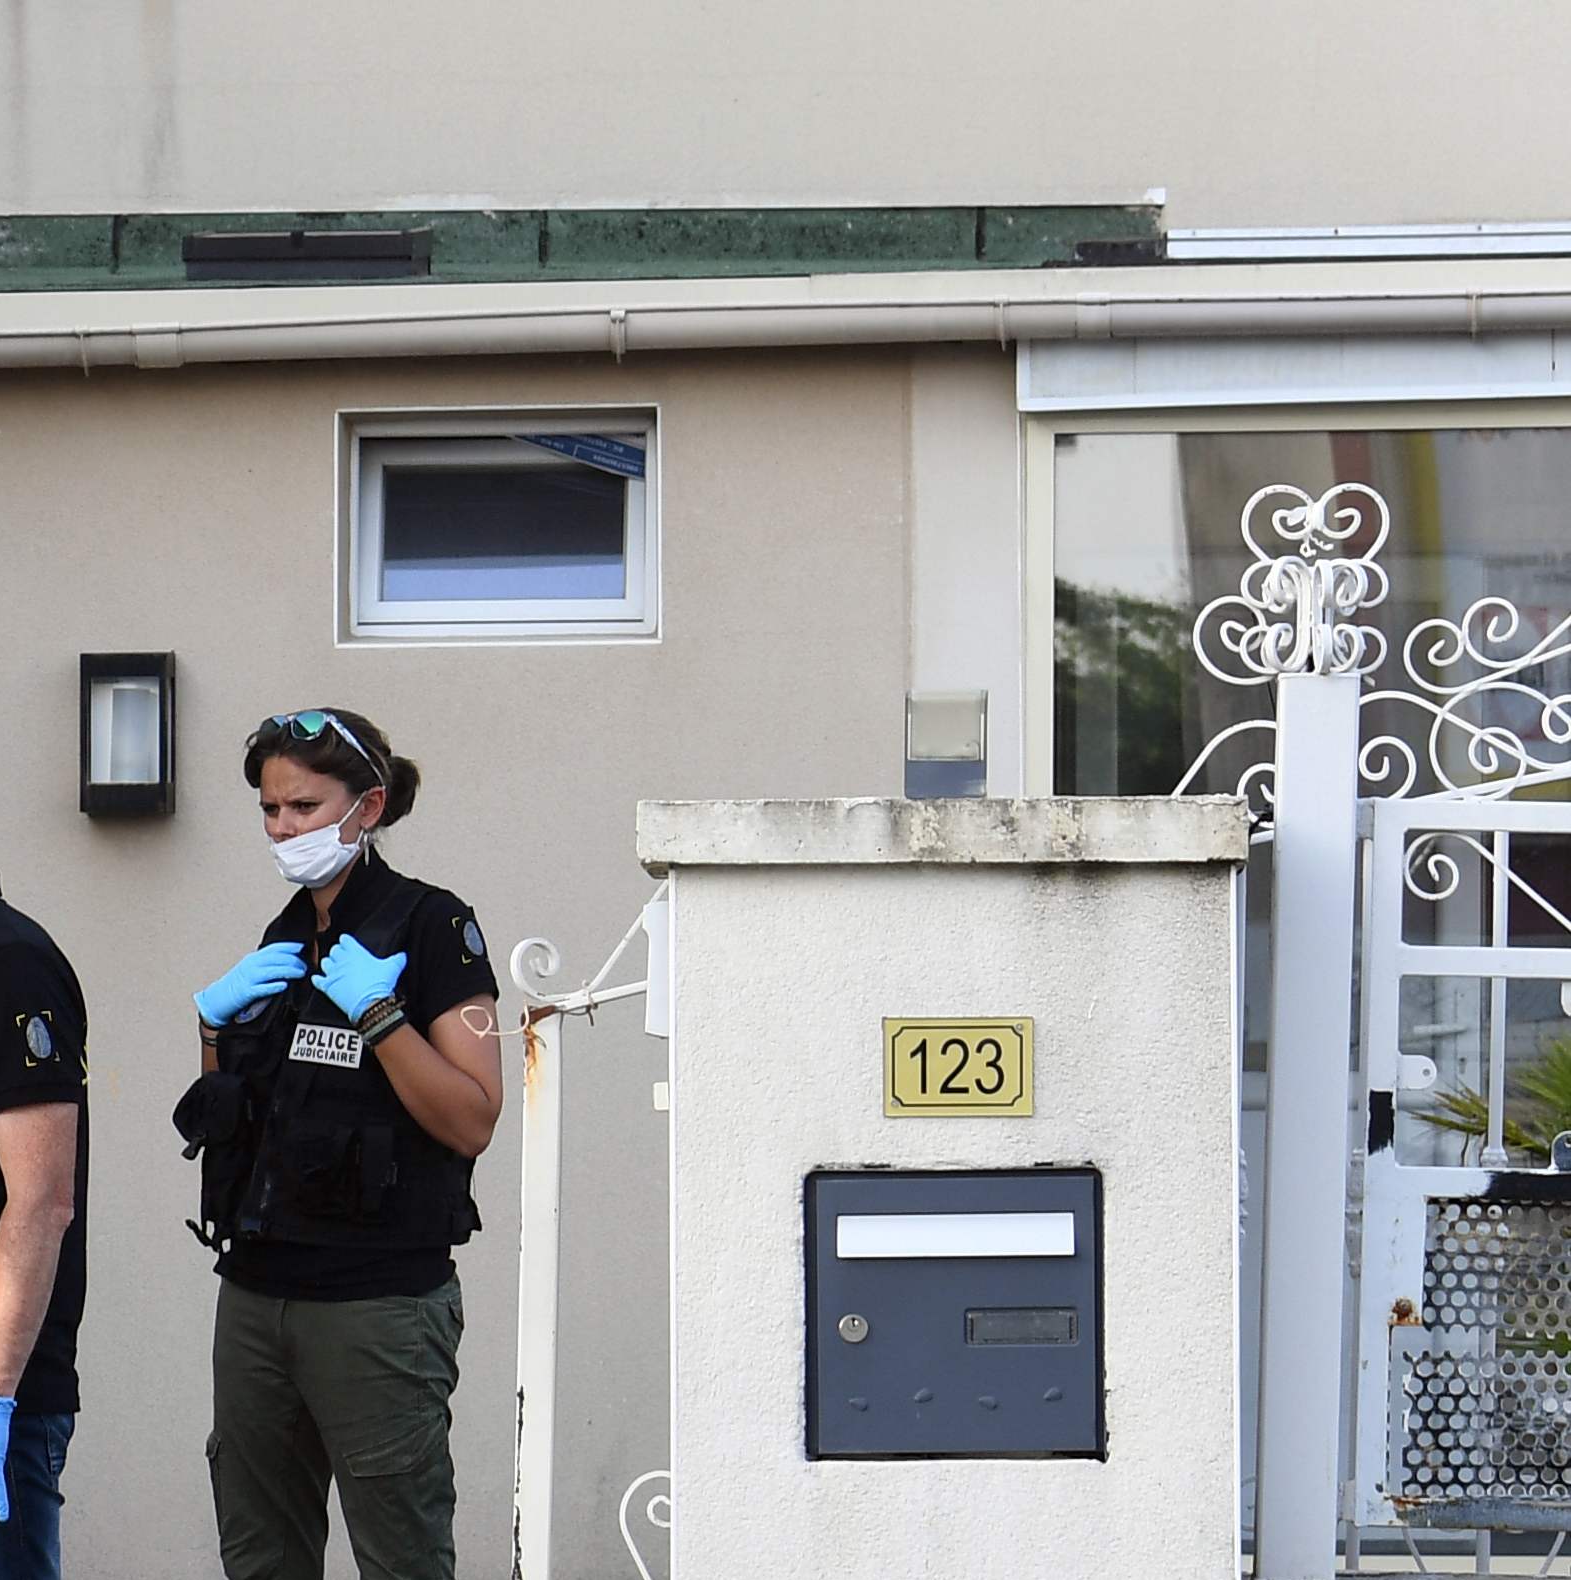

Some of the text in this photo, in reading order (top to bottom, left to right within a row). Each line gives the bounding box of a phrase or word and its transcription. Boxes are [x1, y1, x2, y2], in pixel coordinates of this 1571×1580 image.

[296, 1028, 359, 1052] POLICE
[293, 1046, 356, 1064] JUDICIAIRE
[908, 1037, 1006, 1096] 123
